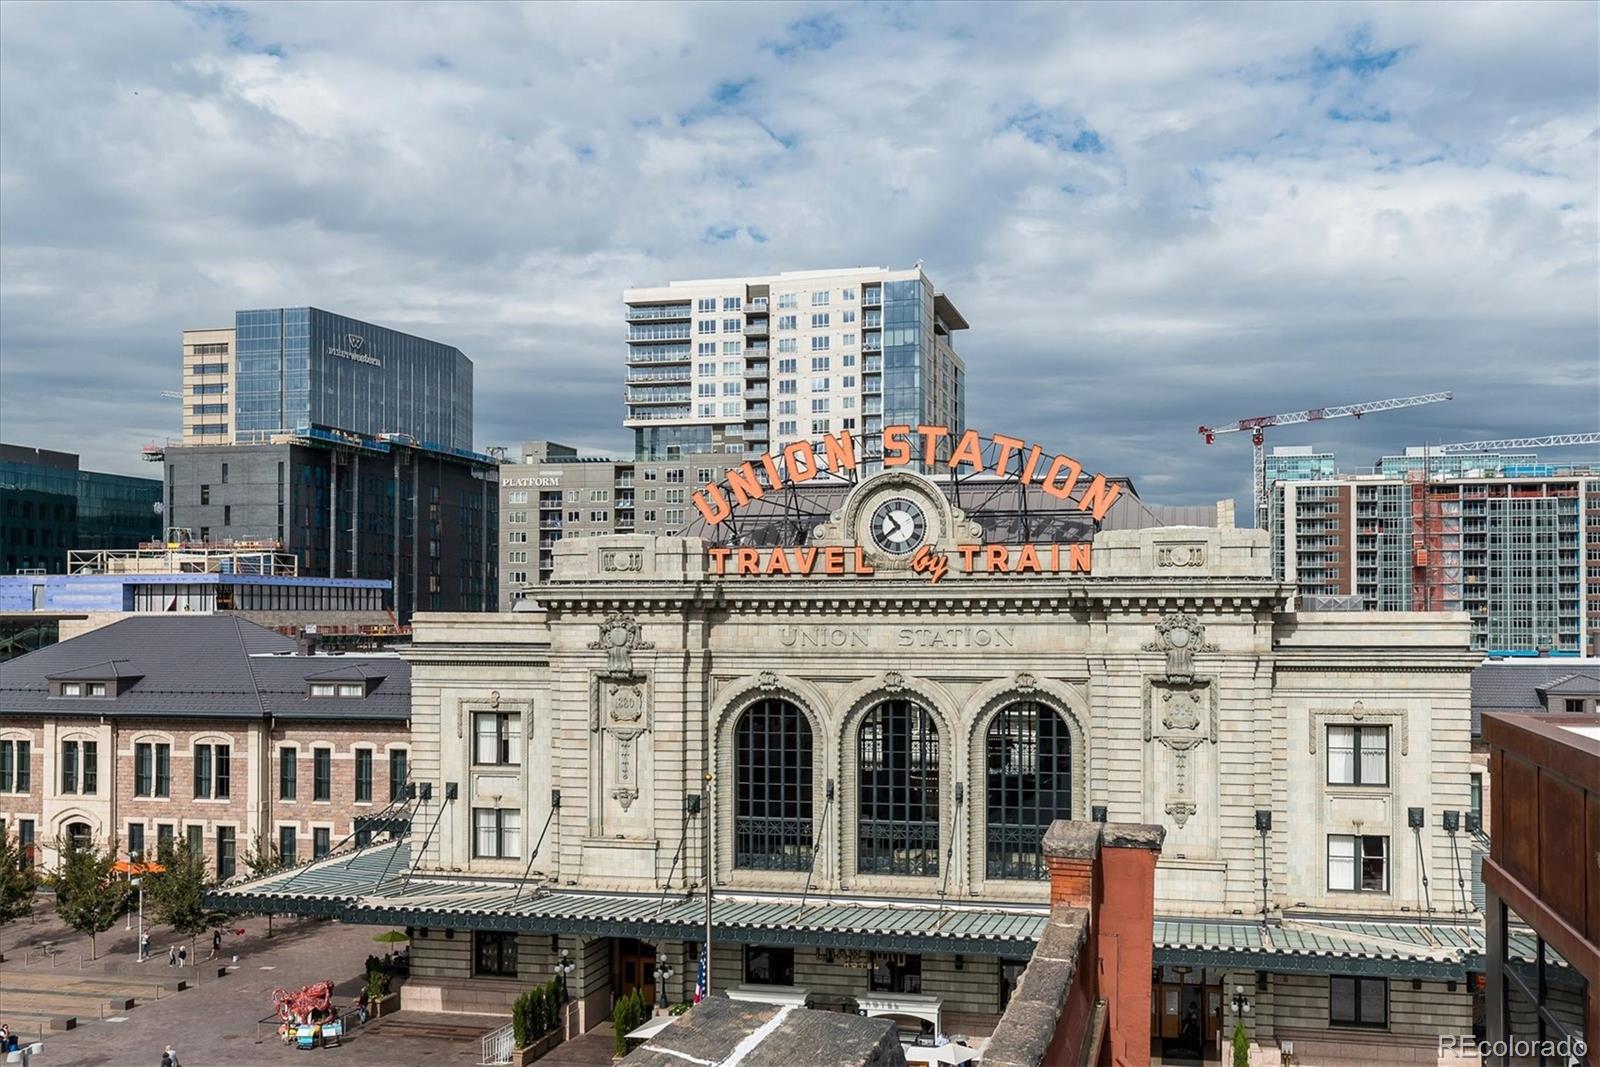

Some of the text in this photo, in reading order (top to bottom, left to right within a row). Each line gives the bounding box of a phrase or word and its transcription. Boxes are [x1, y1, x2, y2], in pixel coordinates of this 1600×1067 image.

[502, 477, 560, 487] PLATFORM
[692, 424, 1121, 525] UNION STATION
[709, 543, 1092, 584] TRAVEL by TRAIN
[779, 627, 1015, 648] UNION STATION
[843, 961, 880, 970] HOTEL
